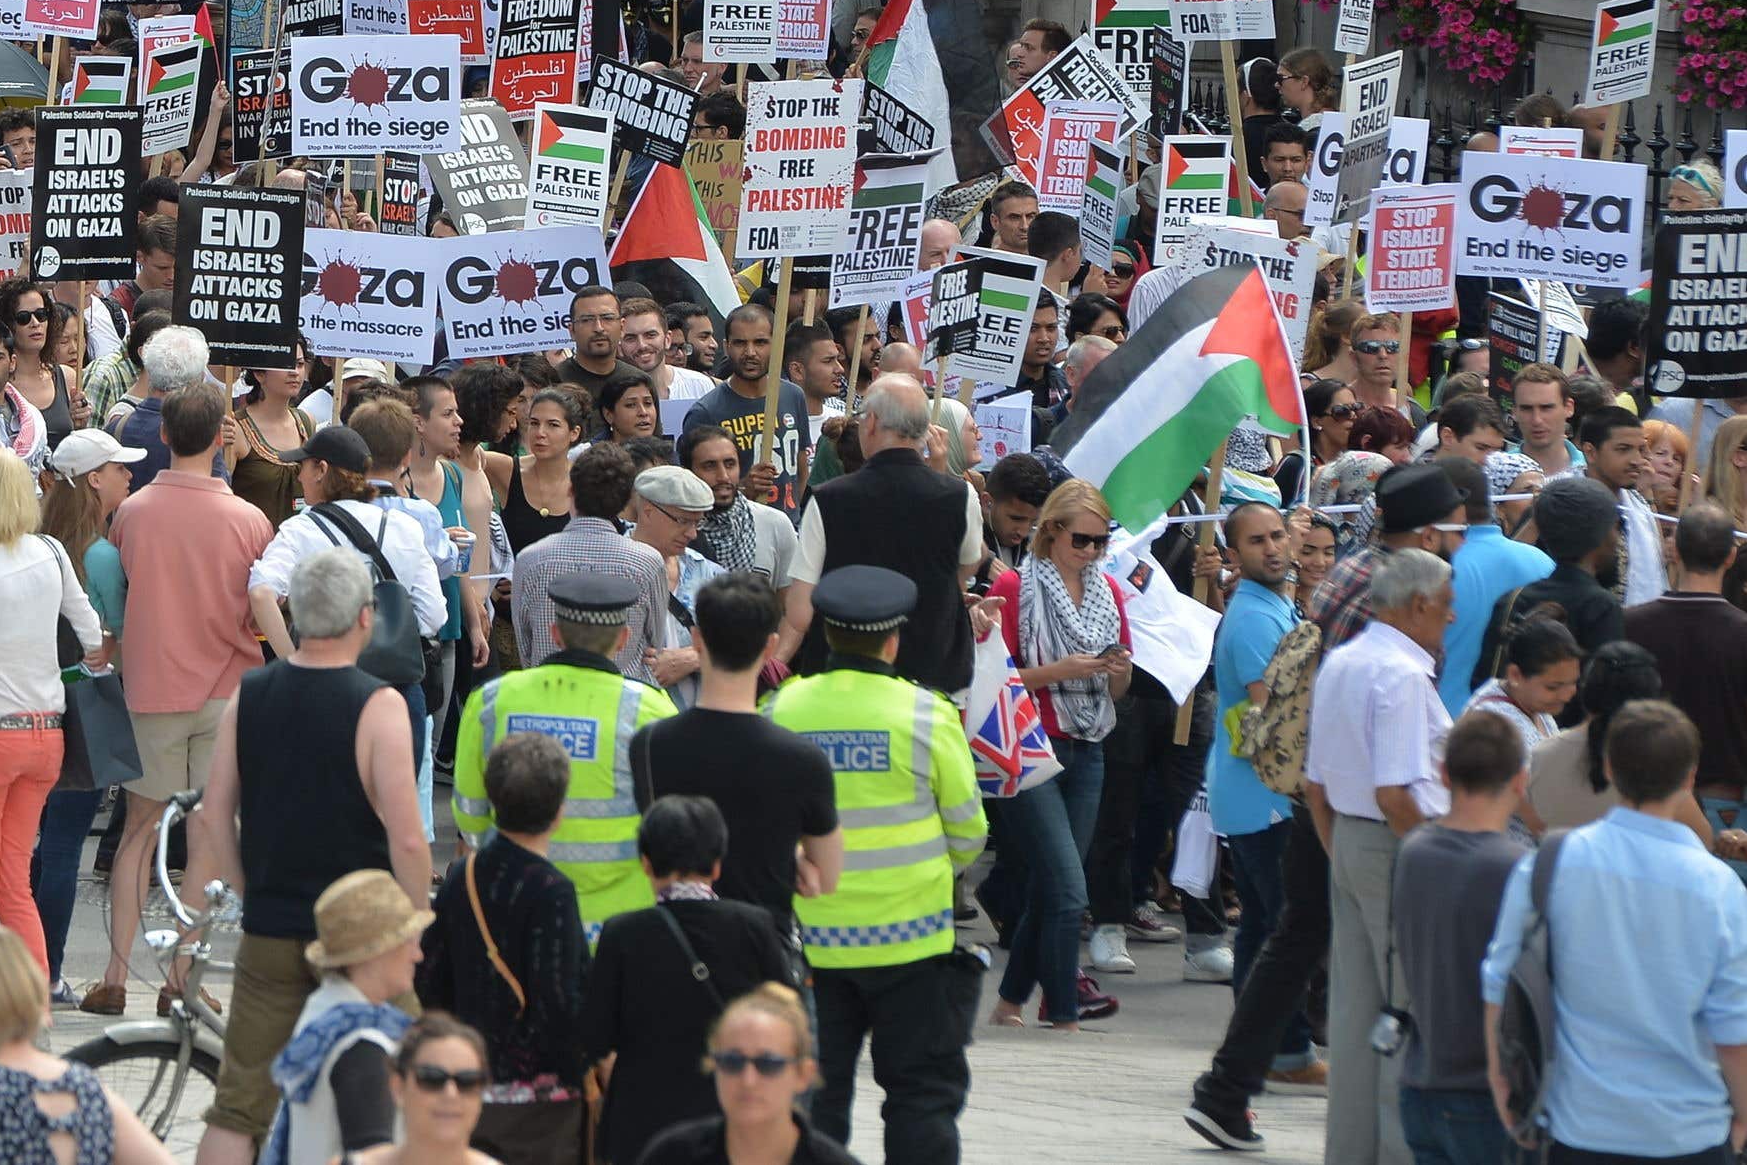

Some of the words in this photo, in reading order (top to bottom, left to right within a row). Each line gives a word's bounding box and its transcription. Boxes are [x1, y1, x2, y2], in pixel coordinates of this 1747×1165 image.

[710, 5, 772, 20] FREE
[709, 21, 772, 31] PALESTINE
[1181, 14, 1210, 34] FOA
[499, 30, 575, 57] PALESTINE
[1596, 44, 1650, 65] FREE
[41, 110, 72, 119] Palestine
[75, 110, 106, 120] Solidarity
[109, 110, 138, 120] Campaign
[765, 98, 809, 119] STOP
[814, 98, 840, 116] THE
[300, 119, 340, 136] End
[347, 119, 382, 136] the
[387, 119, 449, 141] siege
[755, 128, 845, 151] BOMBING
[54, 129, 121, 165] END
[689, 143, 724, 164] THIS
[536, 164, 601, 188] FREE
[780, 158, 814, 178] FREE
[48, 169, 125, 190] ISRAEL'S
[535, 183, 600, 200] PALESTINE
[748, 188, 845, 212] PALESTINE
[47, 192, 124, 214] ATTACKS
[1165, 197, 1222, 214] FREE
[46, 218, 72, 238] ON
[77, 217, 123, 237] GAZA
[200, 208, 279, 247] END
[1392, 208, 1439, 228] STOP
[748, 228, 780, 250] FOA
[1382, 228, 1445, 248] ISRAELI
[192, 250, 284, 273] ISRAEL'S
[834, 247, 915, 272] PALESTINE
[1386, 248, 1436, 269] STATE
[1466, 237, 1511, 259] End
[1516, 238, 1556, 263] the
[1562, 244, 1629, 270] siege
[190, 276, 282, 301] ATTACKS
[1378, 268, 1443, 290] TERROR
[190, 301, 221, 322] ON
[226, 301, 281, 323] GAZA
[311, 316, 339, 333] the
[344, 318, 424, 337] massacre
[452, 319, 497, 339] End
[505, 317, 537, 334] the
[510, 717, 591, 734] METROPOLITAN
